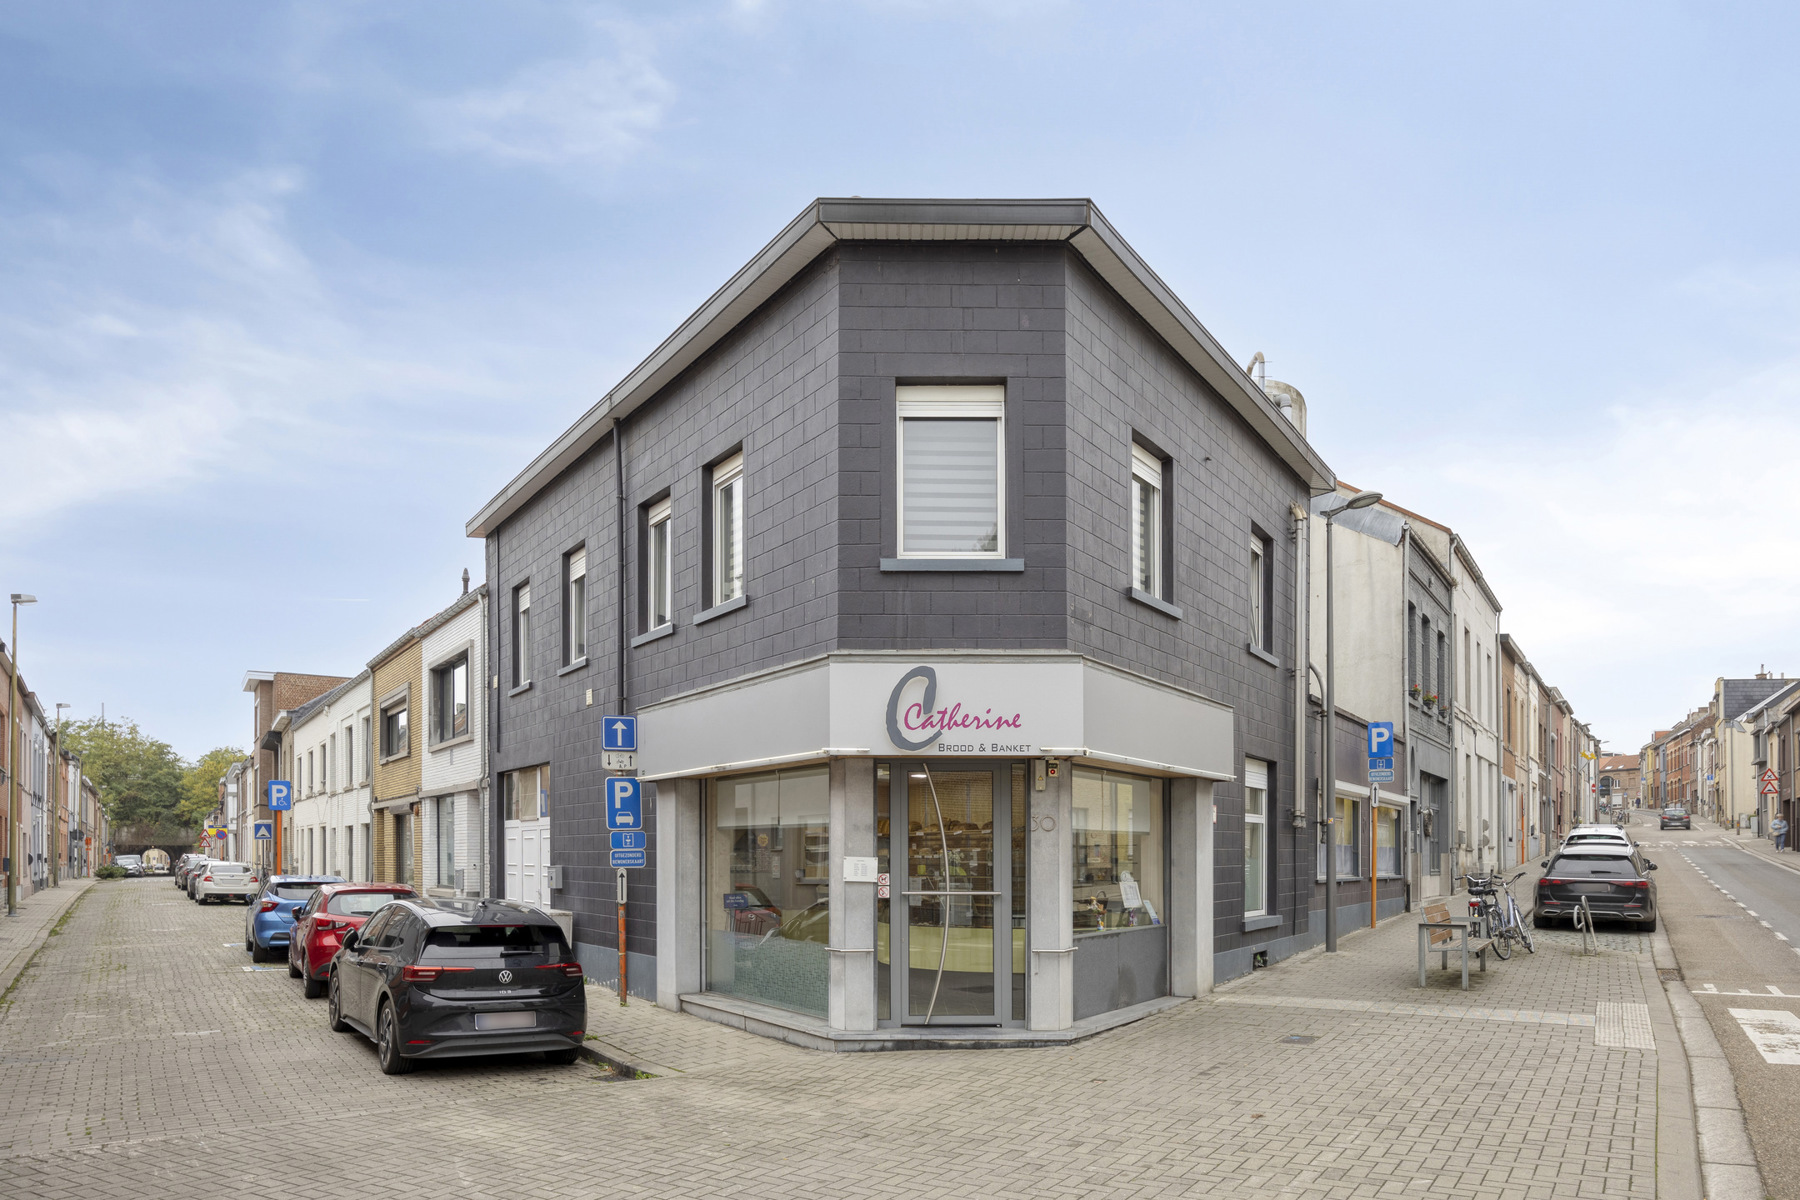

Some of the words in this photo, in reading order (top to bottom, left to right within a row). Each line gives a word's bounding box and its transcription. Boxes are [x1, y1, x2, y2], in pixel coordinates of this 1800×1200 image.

[904, 702, 1022, 731] Catherine
[978, 743, 986, 752] &
[1371, 727, 1390, 753] P
[271, 784, 288, 806] P
[614, 781, 634, 809] P
